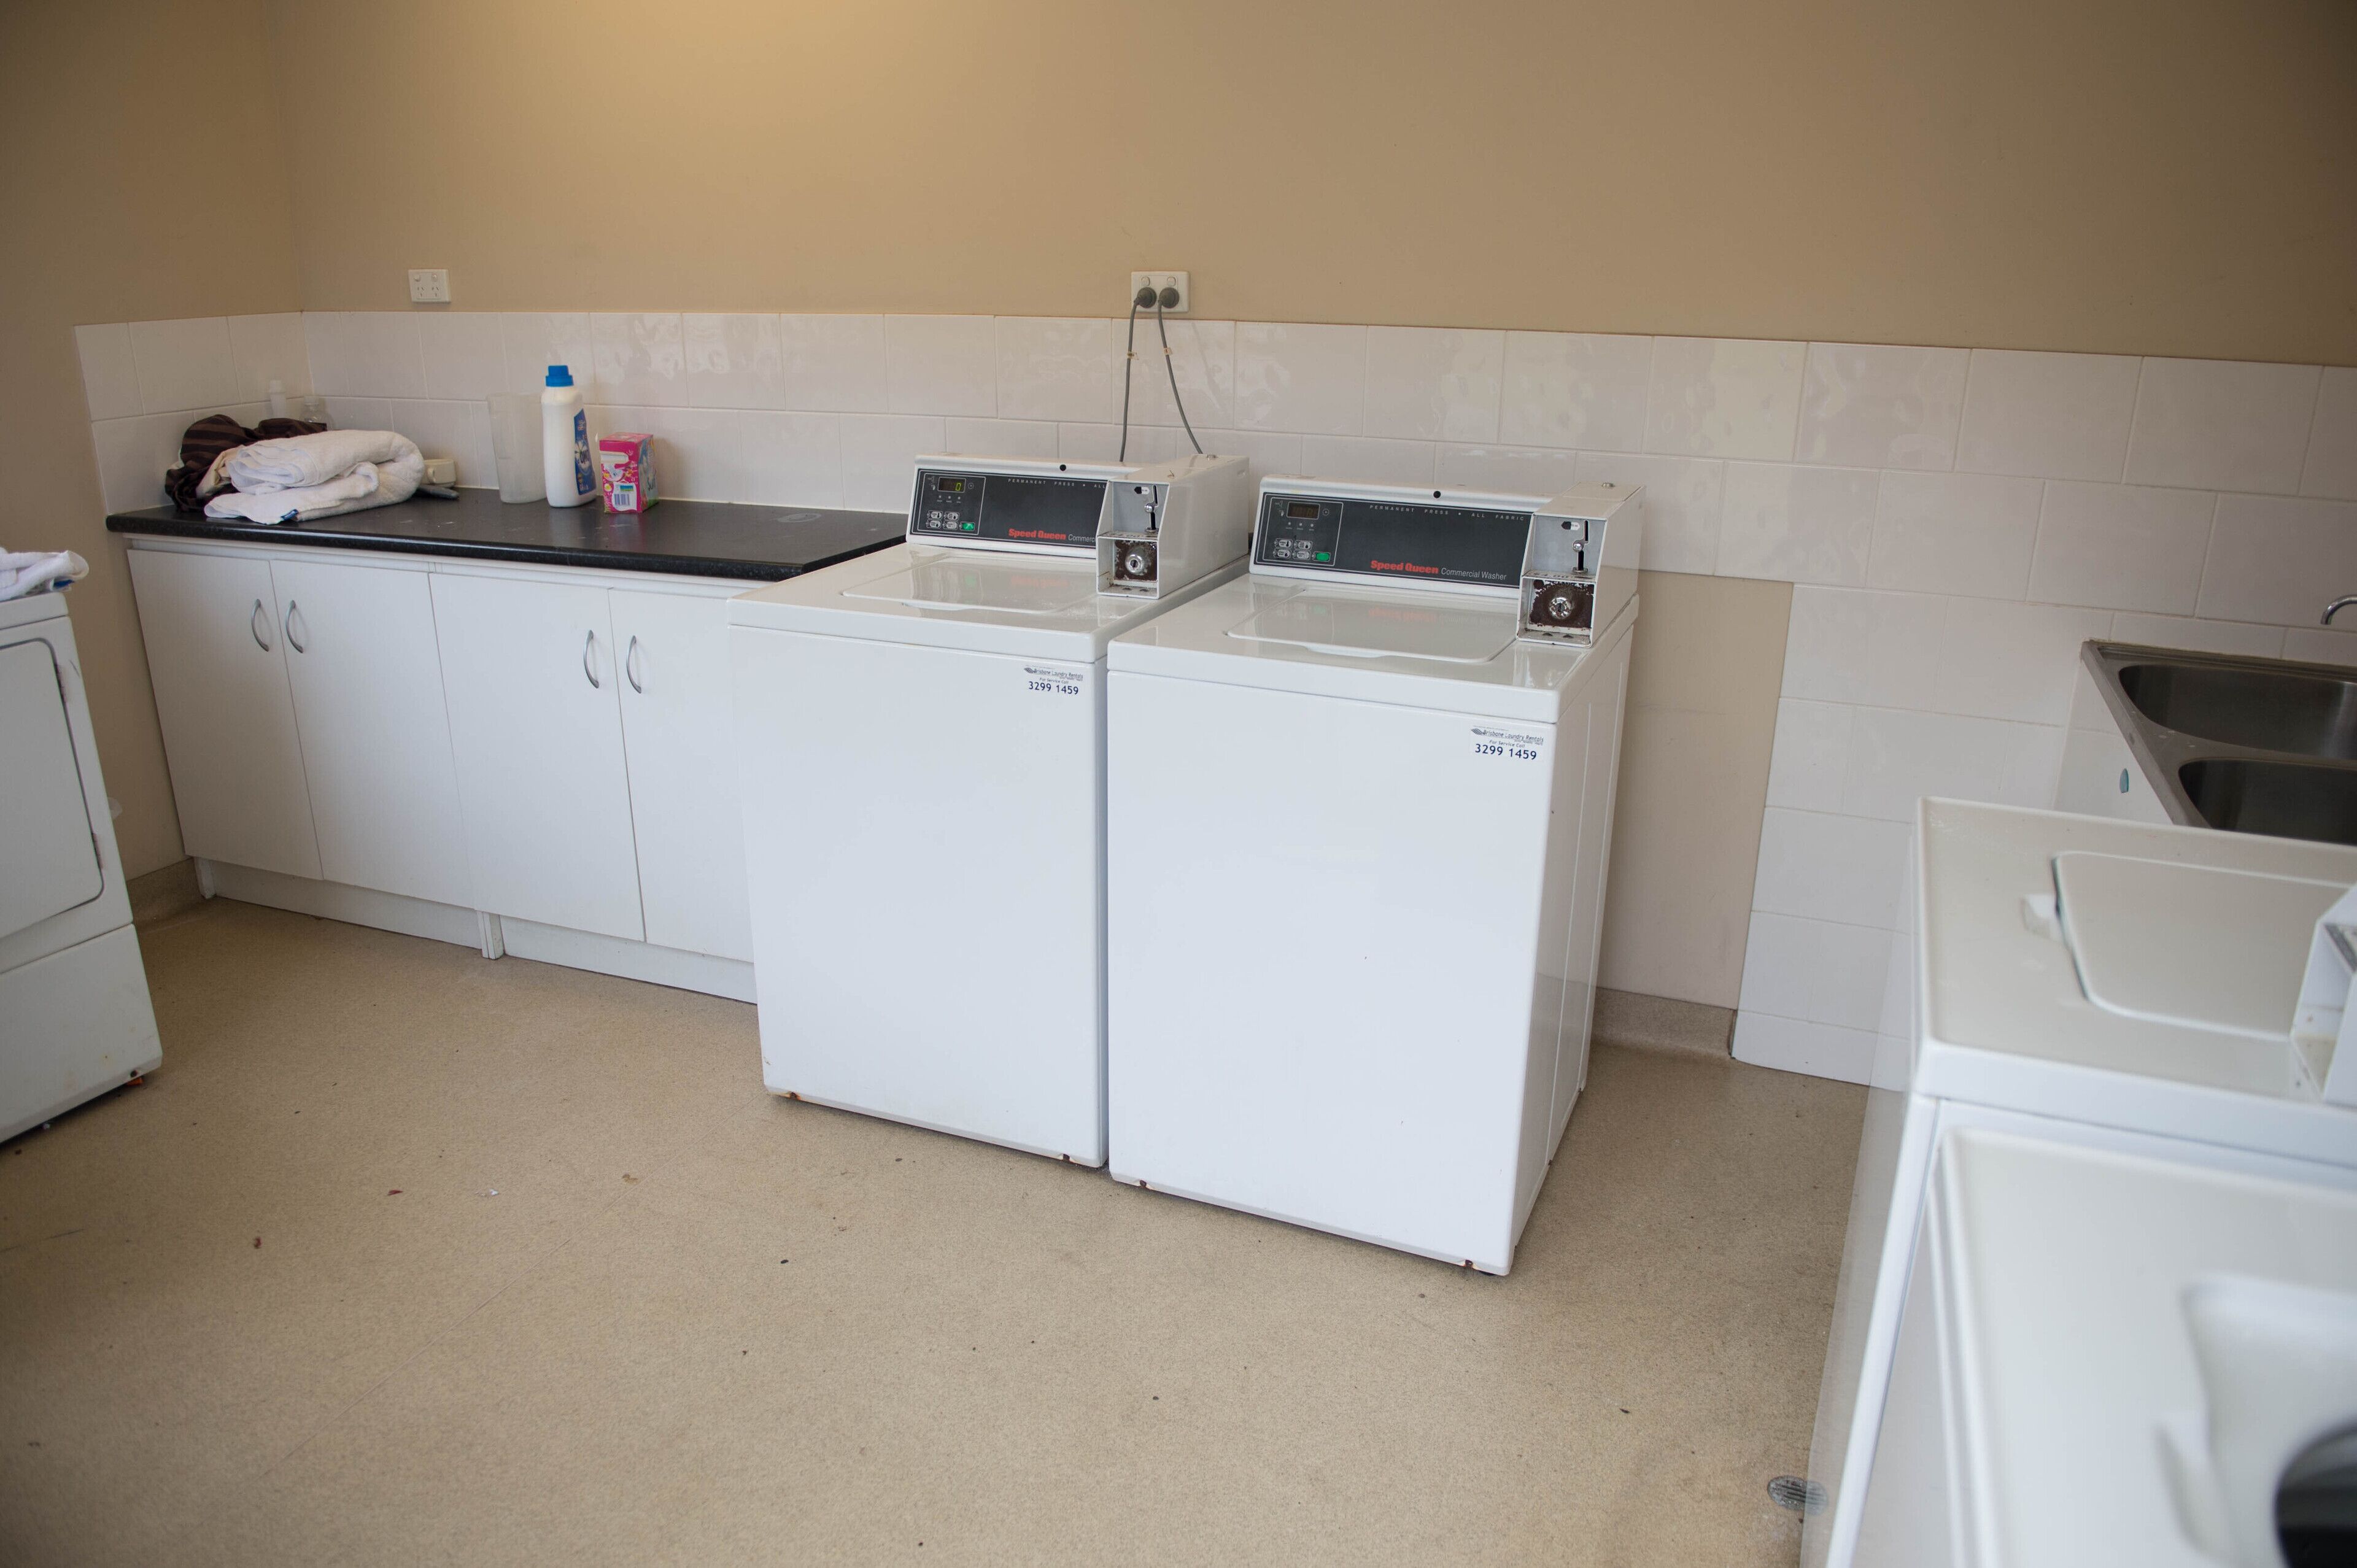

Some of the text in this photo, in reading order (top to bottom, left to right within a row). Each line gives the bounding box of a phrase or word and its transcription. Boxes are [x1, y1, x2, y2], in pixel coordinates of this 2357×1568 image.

[955, 482, 962, 491] 0
[1008, 528, 1037, 538] Speed
[1038, 530, 1066, 540] Queen
[1370, 560, 1507, 580] Speed Queen Commercial Washer
[1029, 681, 1078, 695] 3299 1459
[1475, 743, 1537, 760] 3299 1459
